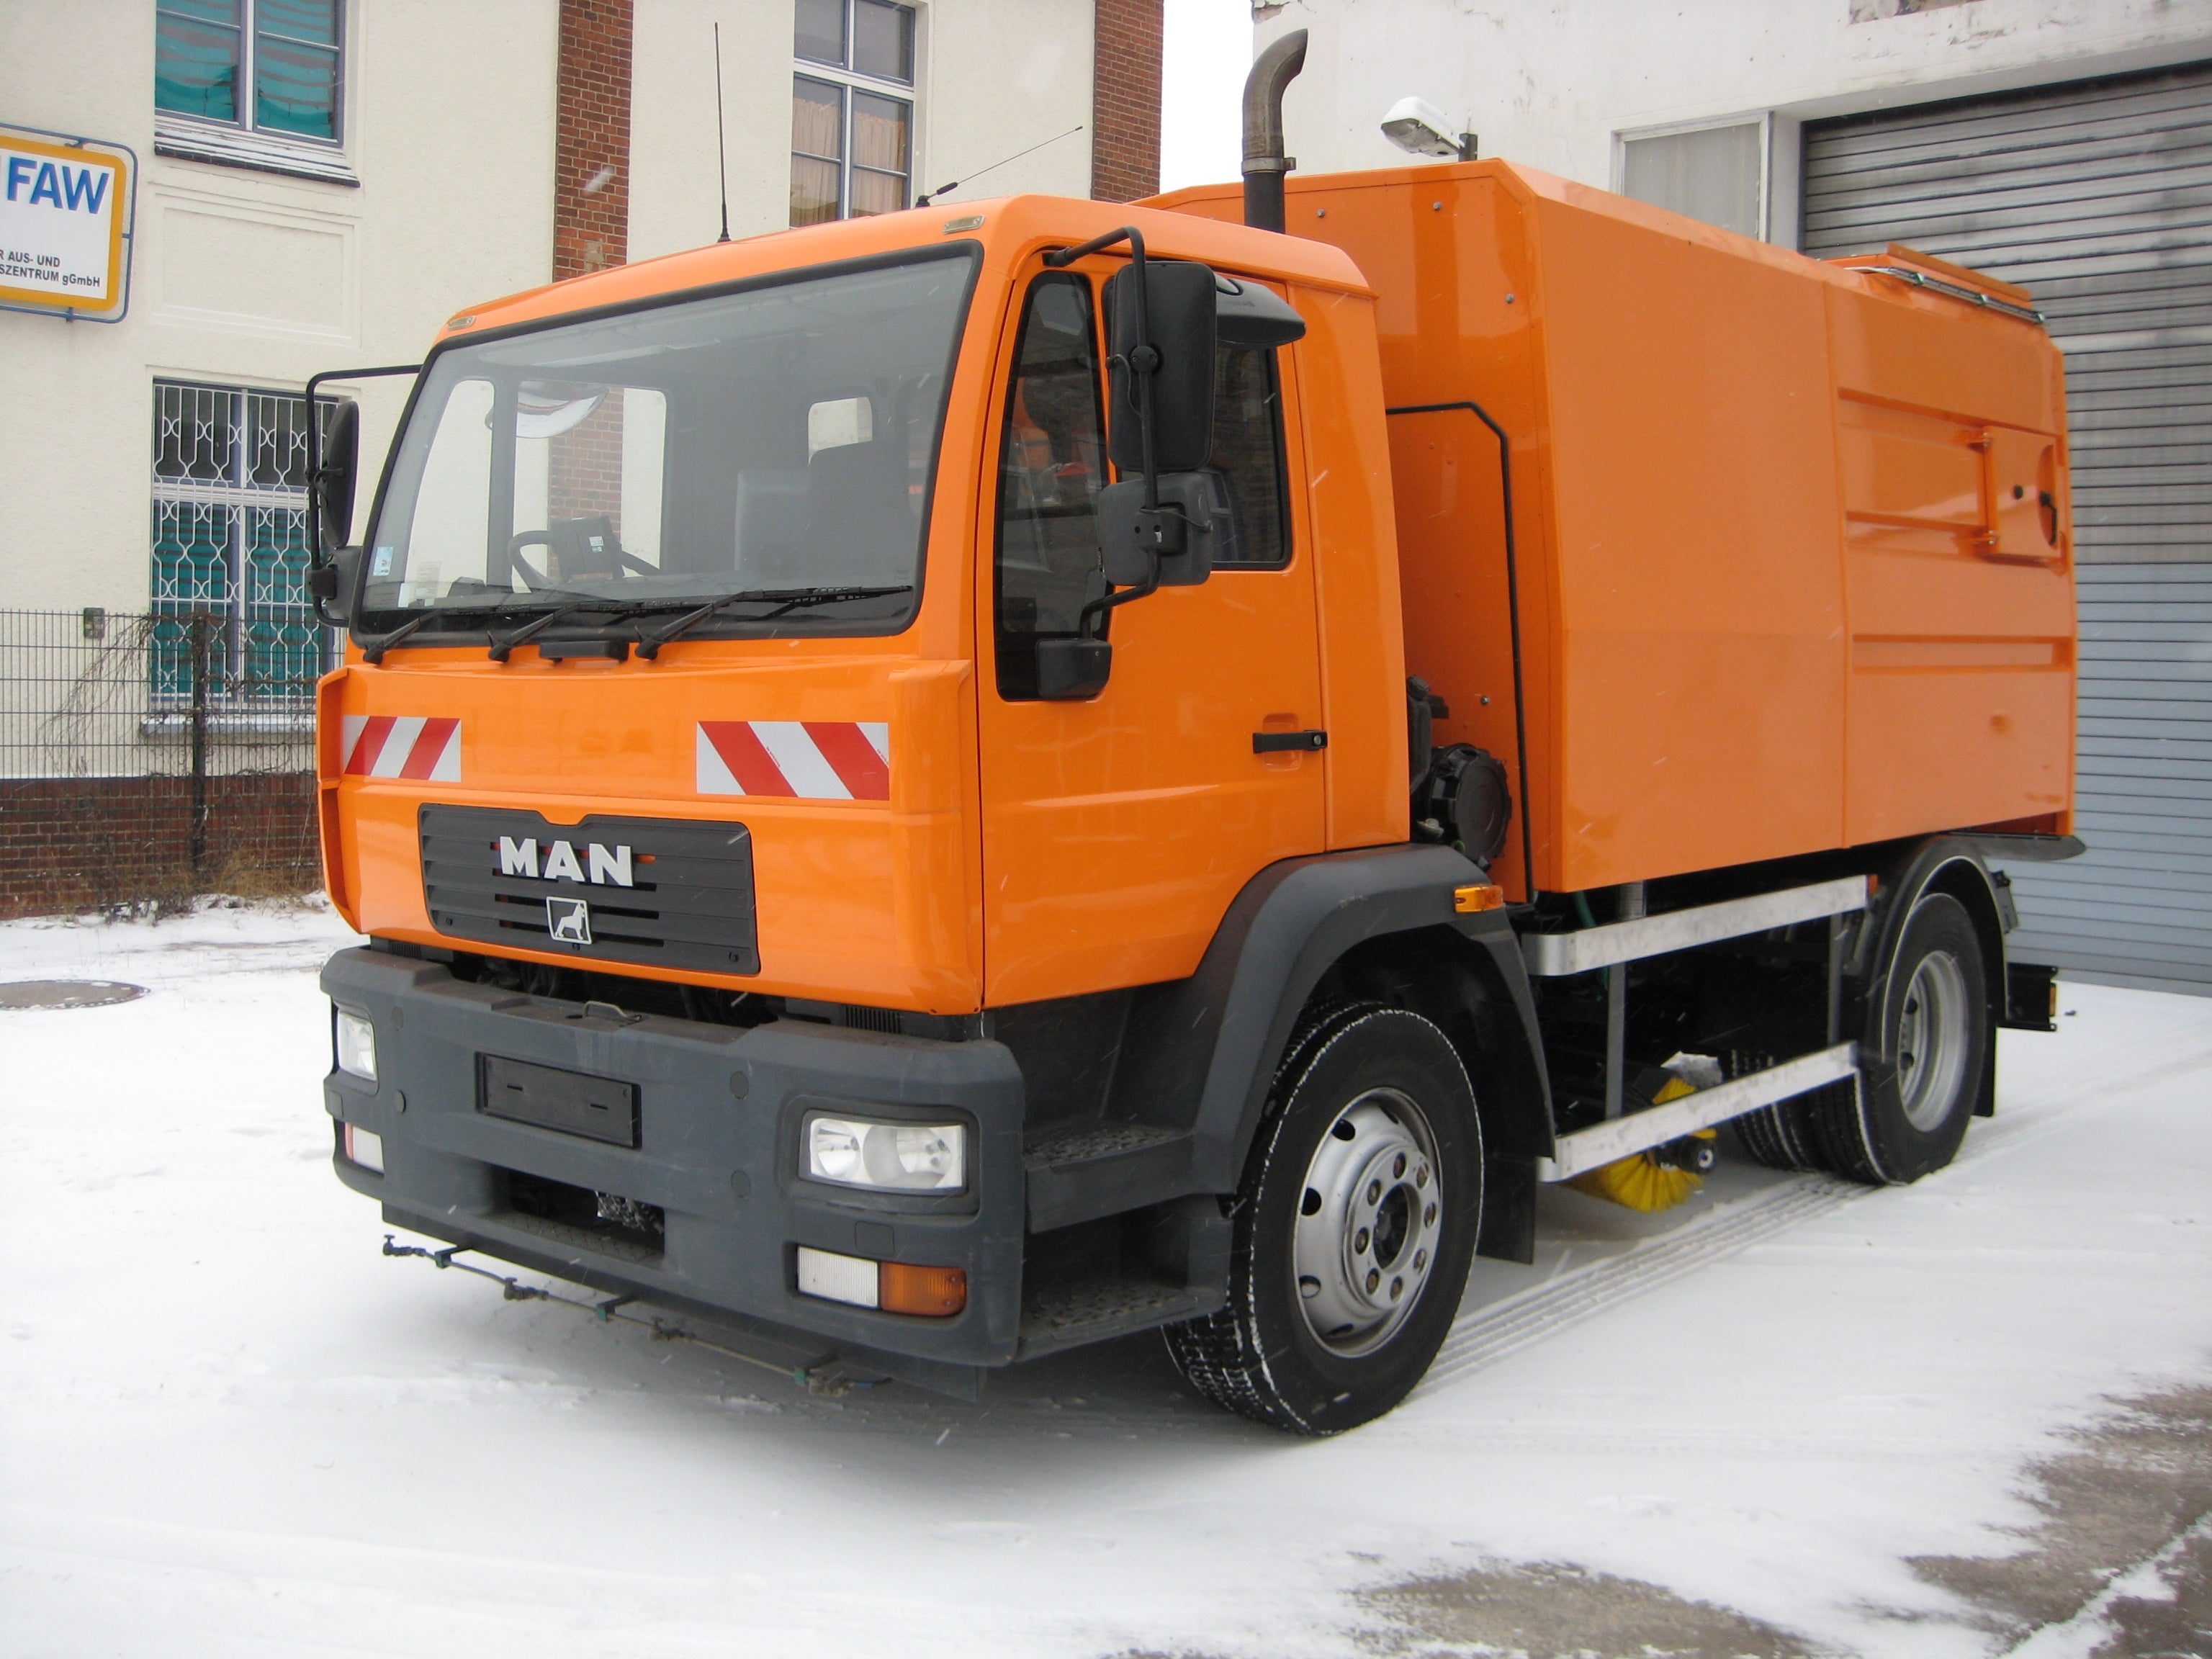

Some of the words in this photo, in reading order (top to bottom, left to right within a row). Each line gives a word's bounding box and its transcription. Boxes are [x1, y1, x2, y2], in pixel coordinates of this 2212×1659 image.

[6, 156, 110, 215] FAW
[8, 251, 34, 264] AUS-
[37, 254, 60, 268] UND
[62, 274, 100, 287] gGmbH
[500, 836, 634, 887] MAN
